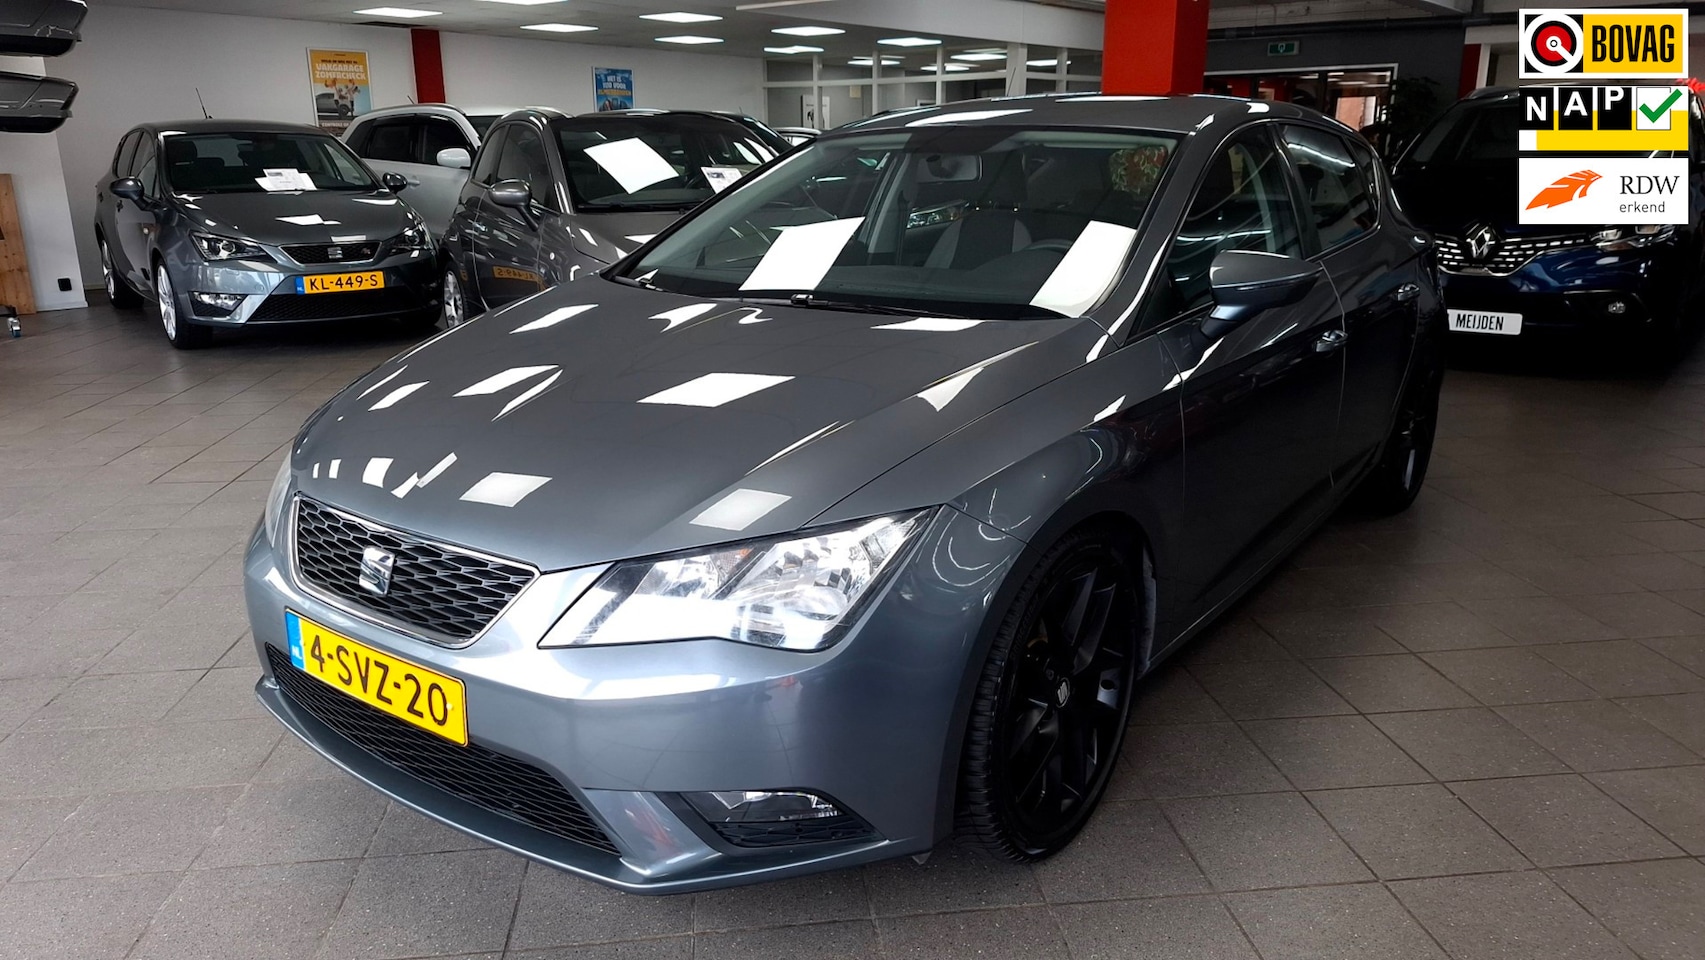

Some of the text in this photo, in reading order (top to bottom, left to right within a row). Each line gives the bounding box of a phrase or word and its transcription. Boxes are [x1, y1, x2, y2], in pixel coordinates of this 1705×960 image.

[315, 71, 366, 80] ZOMERCHECK
[316, 63, 364, 72] VAKGARAGE
[309, 274, 378, 291] KL-449-S
[1456, 313, 1504, 331] MEIJDEN
[310, 634, 449, 727] 4-SVZ-20
